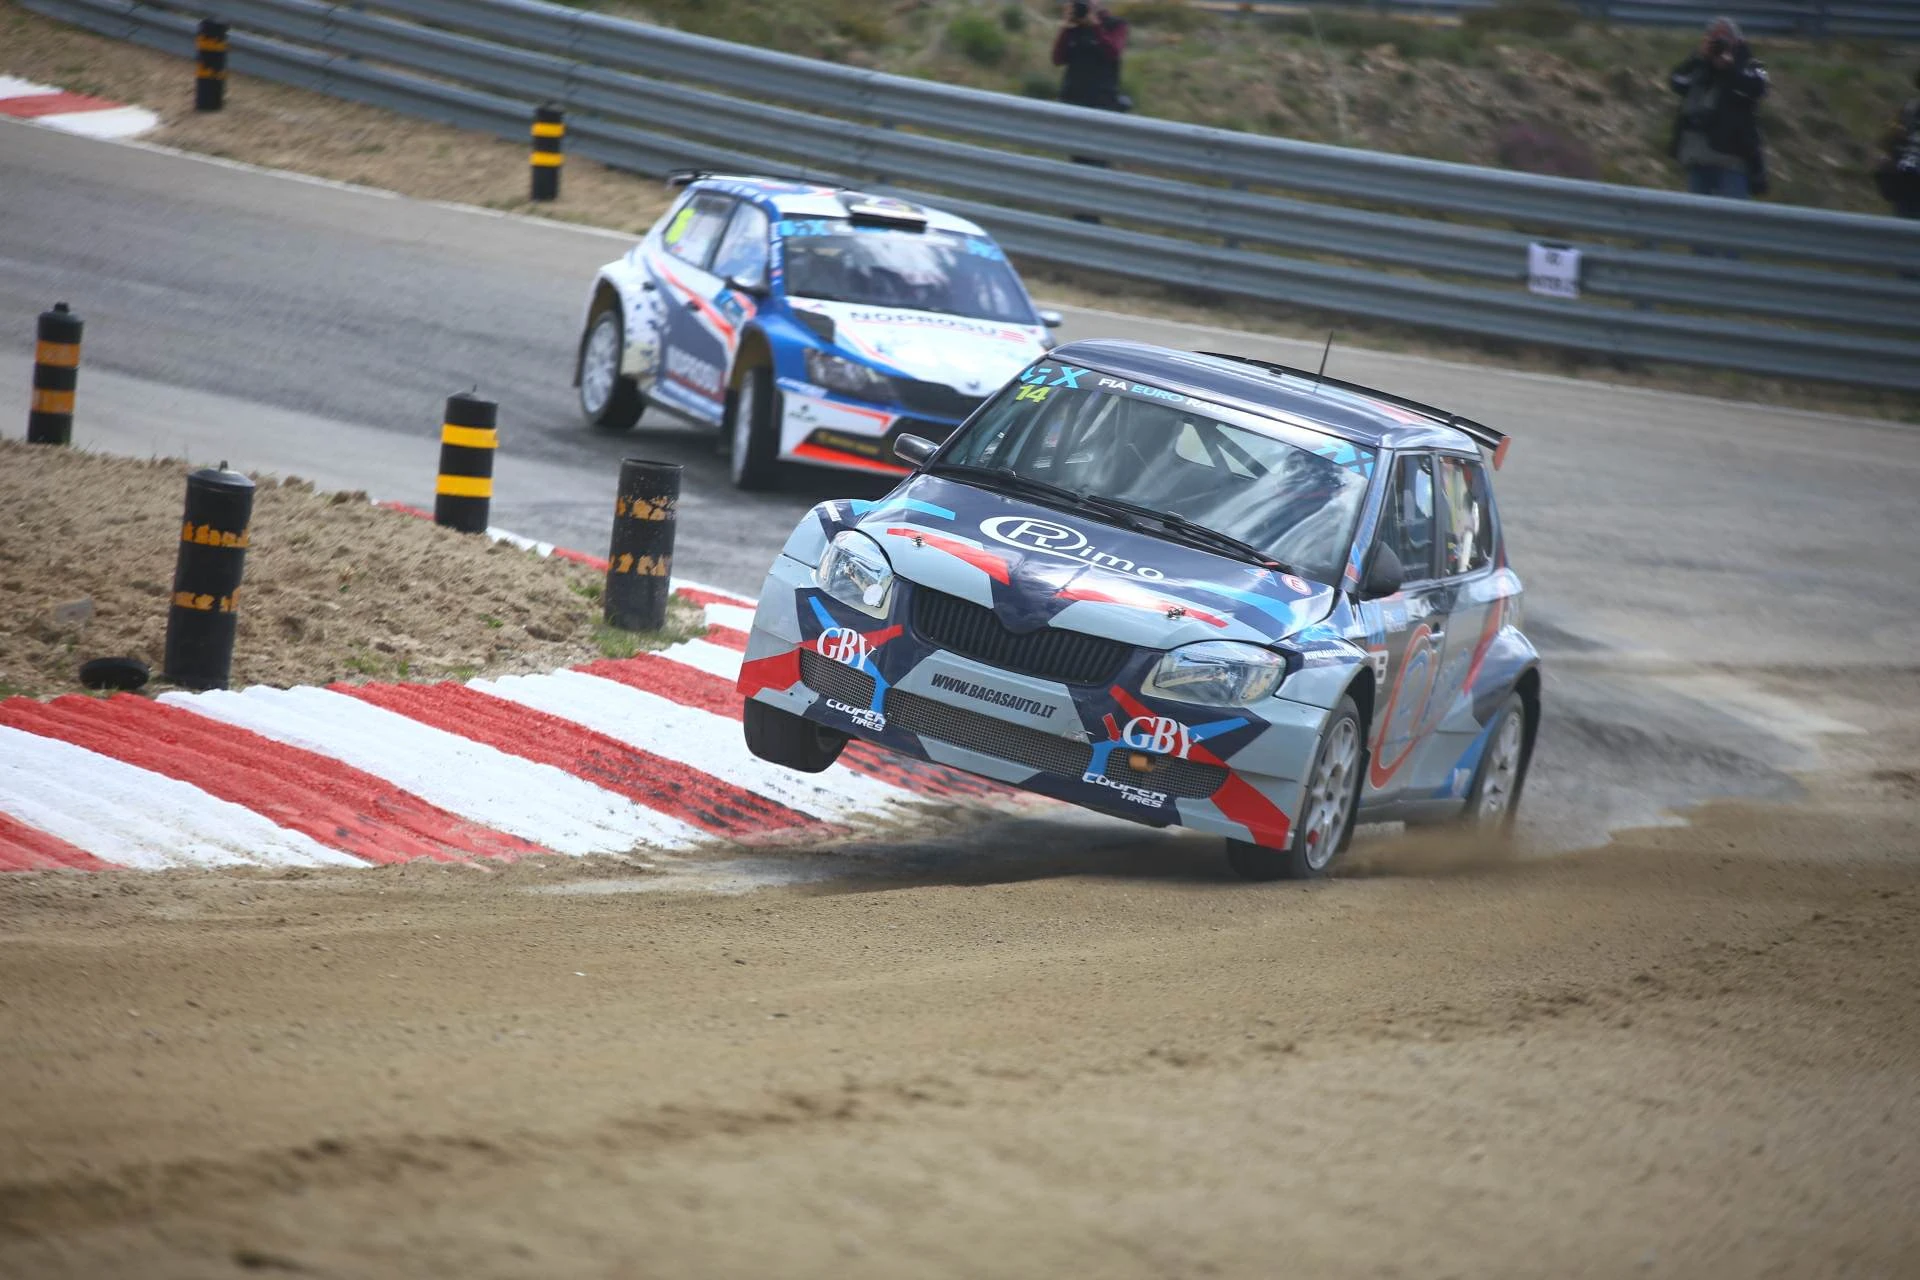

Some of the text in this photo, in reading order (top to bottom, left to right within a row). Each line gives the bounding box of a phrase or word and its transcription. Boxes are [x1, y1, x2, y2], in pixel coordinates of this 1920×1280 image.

[1015, 384, 1051, 403] 14
[1098, 376, 1128, 391] FIA
[1130, 383, 1185, 402] EURO
[816, 626, 878, 672] GBY
[930, 672, 1058, 719] WWW.BACASAUTO.IT
[825, 698, 887, 725] COOPER
[851, 715, 885, 732] TIRES
[1122, 715, 1204, 761] GBY
[1120, 790, 1166, 808] TIRES
